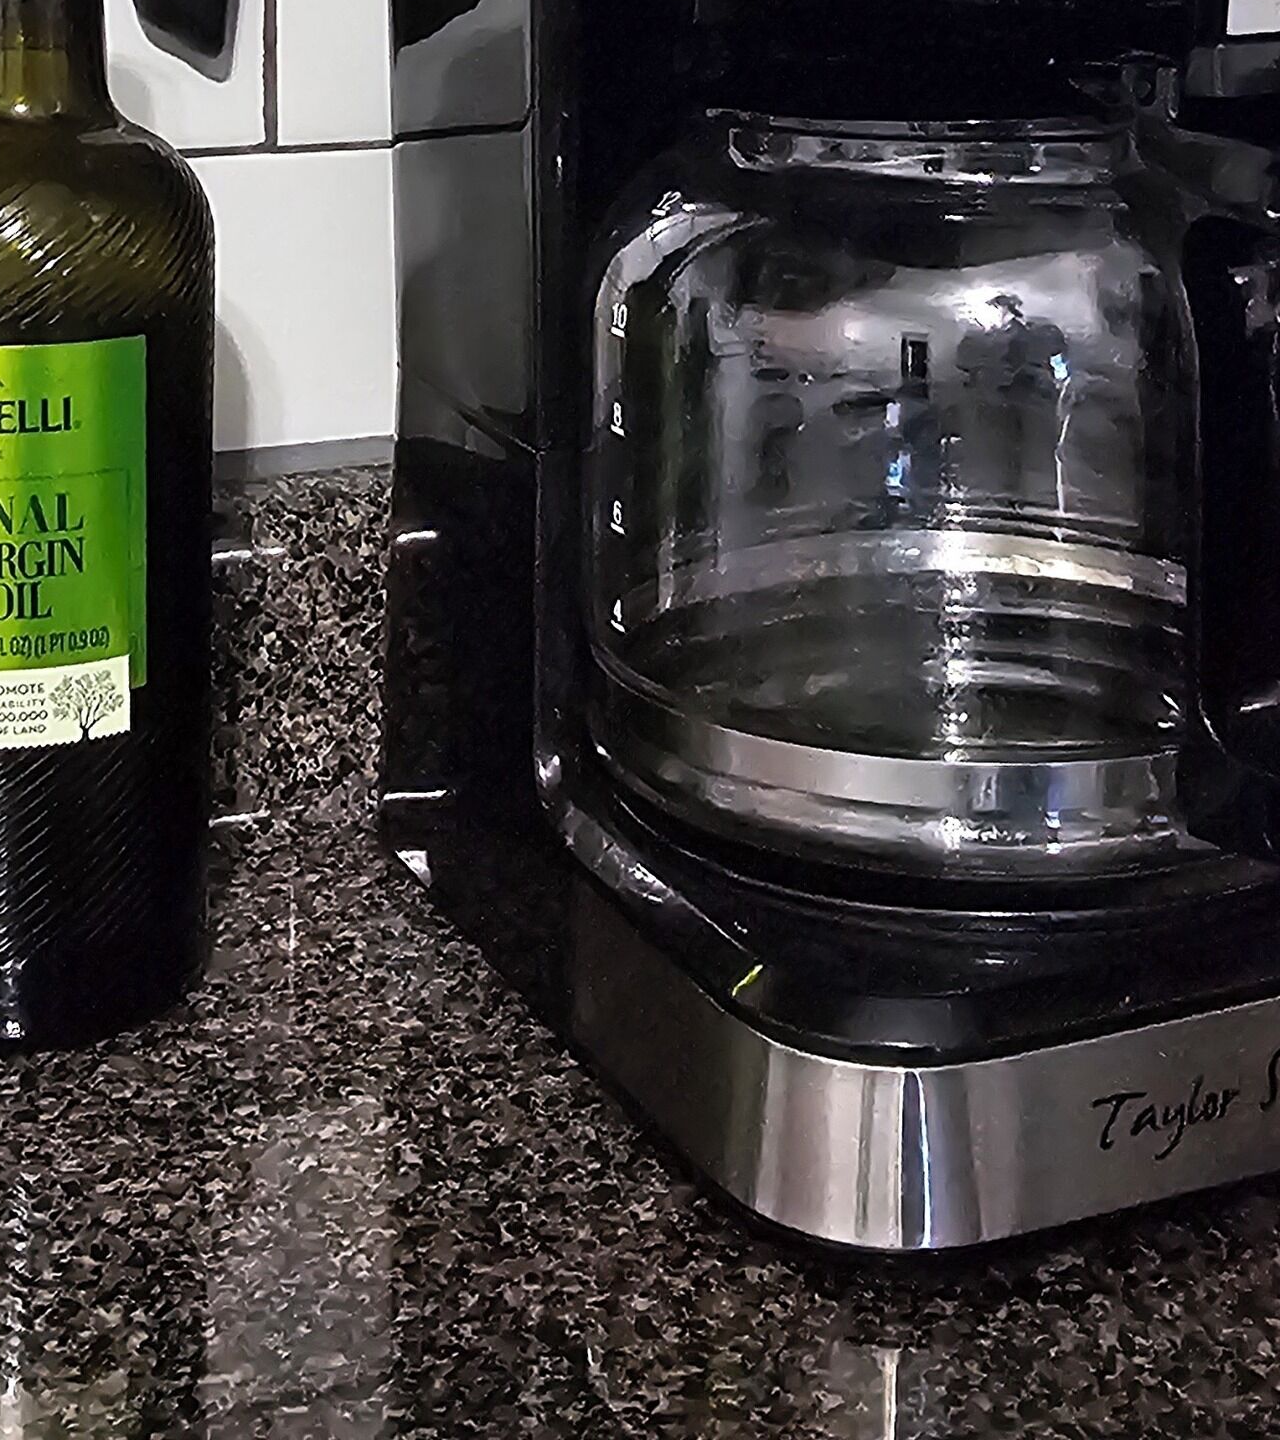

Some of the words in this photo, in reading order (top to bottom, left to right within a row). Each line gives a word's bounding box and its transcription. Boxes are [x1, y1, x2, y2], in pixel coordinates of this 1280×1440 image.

[656, 191, 682, 211] 12
[611, 303, 628, 329] 10
[613, 402, 622, 427] 8
[613, 500, 623, 526] 6
[613, 599, 622, 621] 4
[13, 723, 48, 736] LAND
[1091, 1075, 1241, 1161] Taylor
